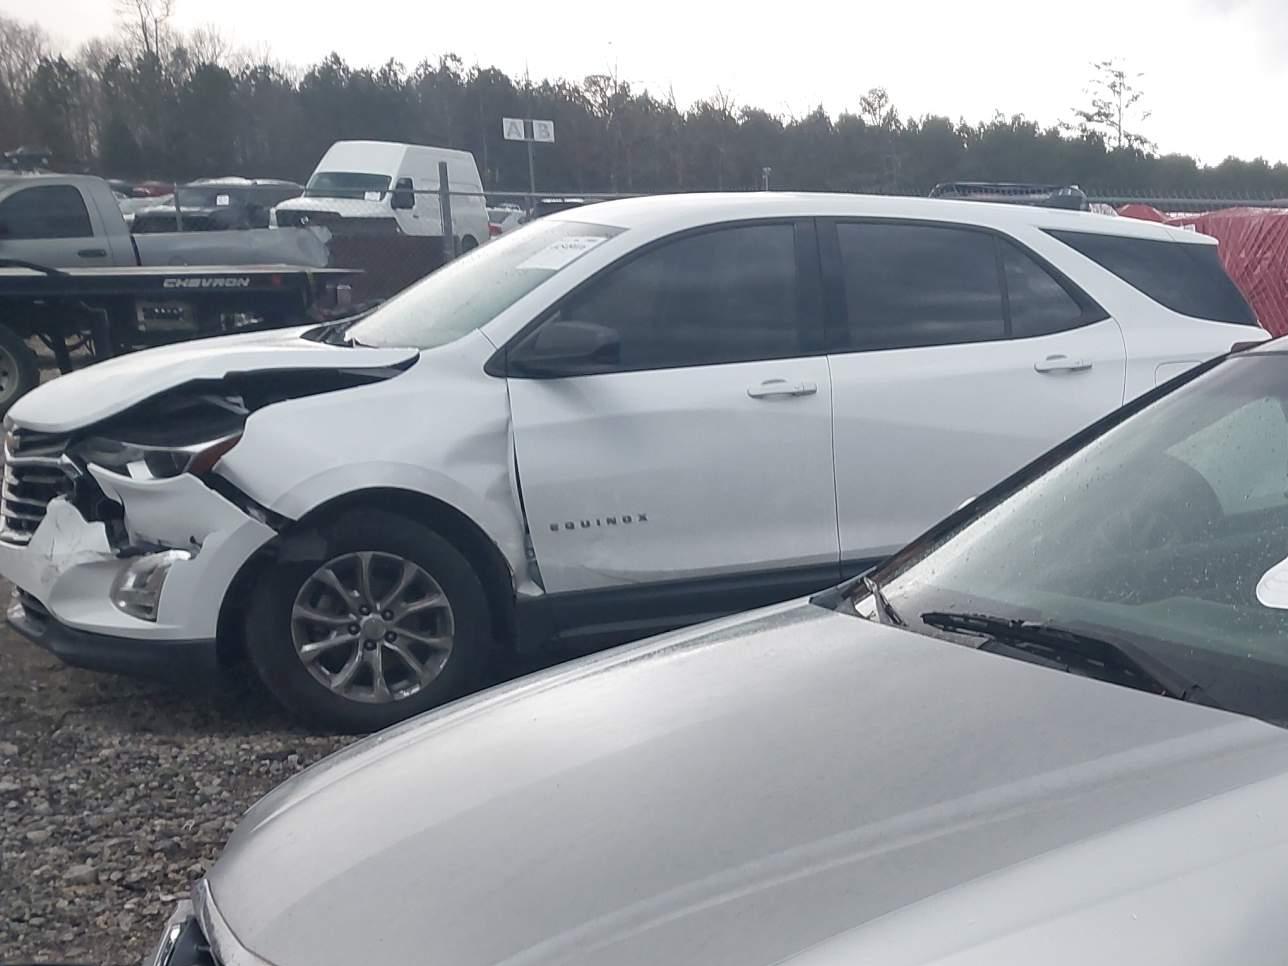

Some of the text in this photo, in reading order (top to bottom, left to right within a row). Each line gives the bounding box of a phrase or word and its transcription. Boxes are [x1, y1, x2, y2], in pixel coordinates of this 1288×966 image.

[507, 121, 522, 138] A
[536, 123, 551, 139] B
[163, 278, 250, 288] CHEVRON
[550, 514, 648, 531] EQUINOX
